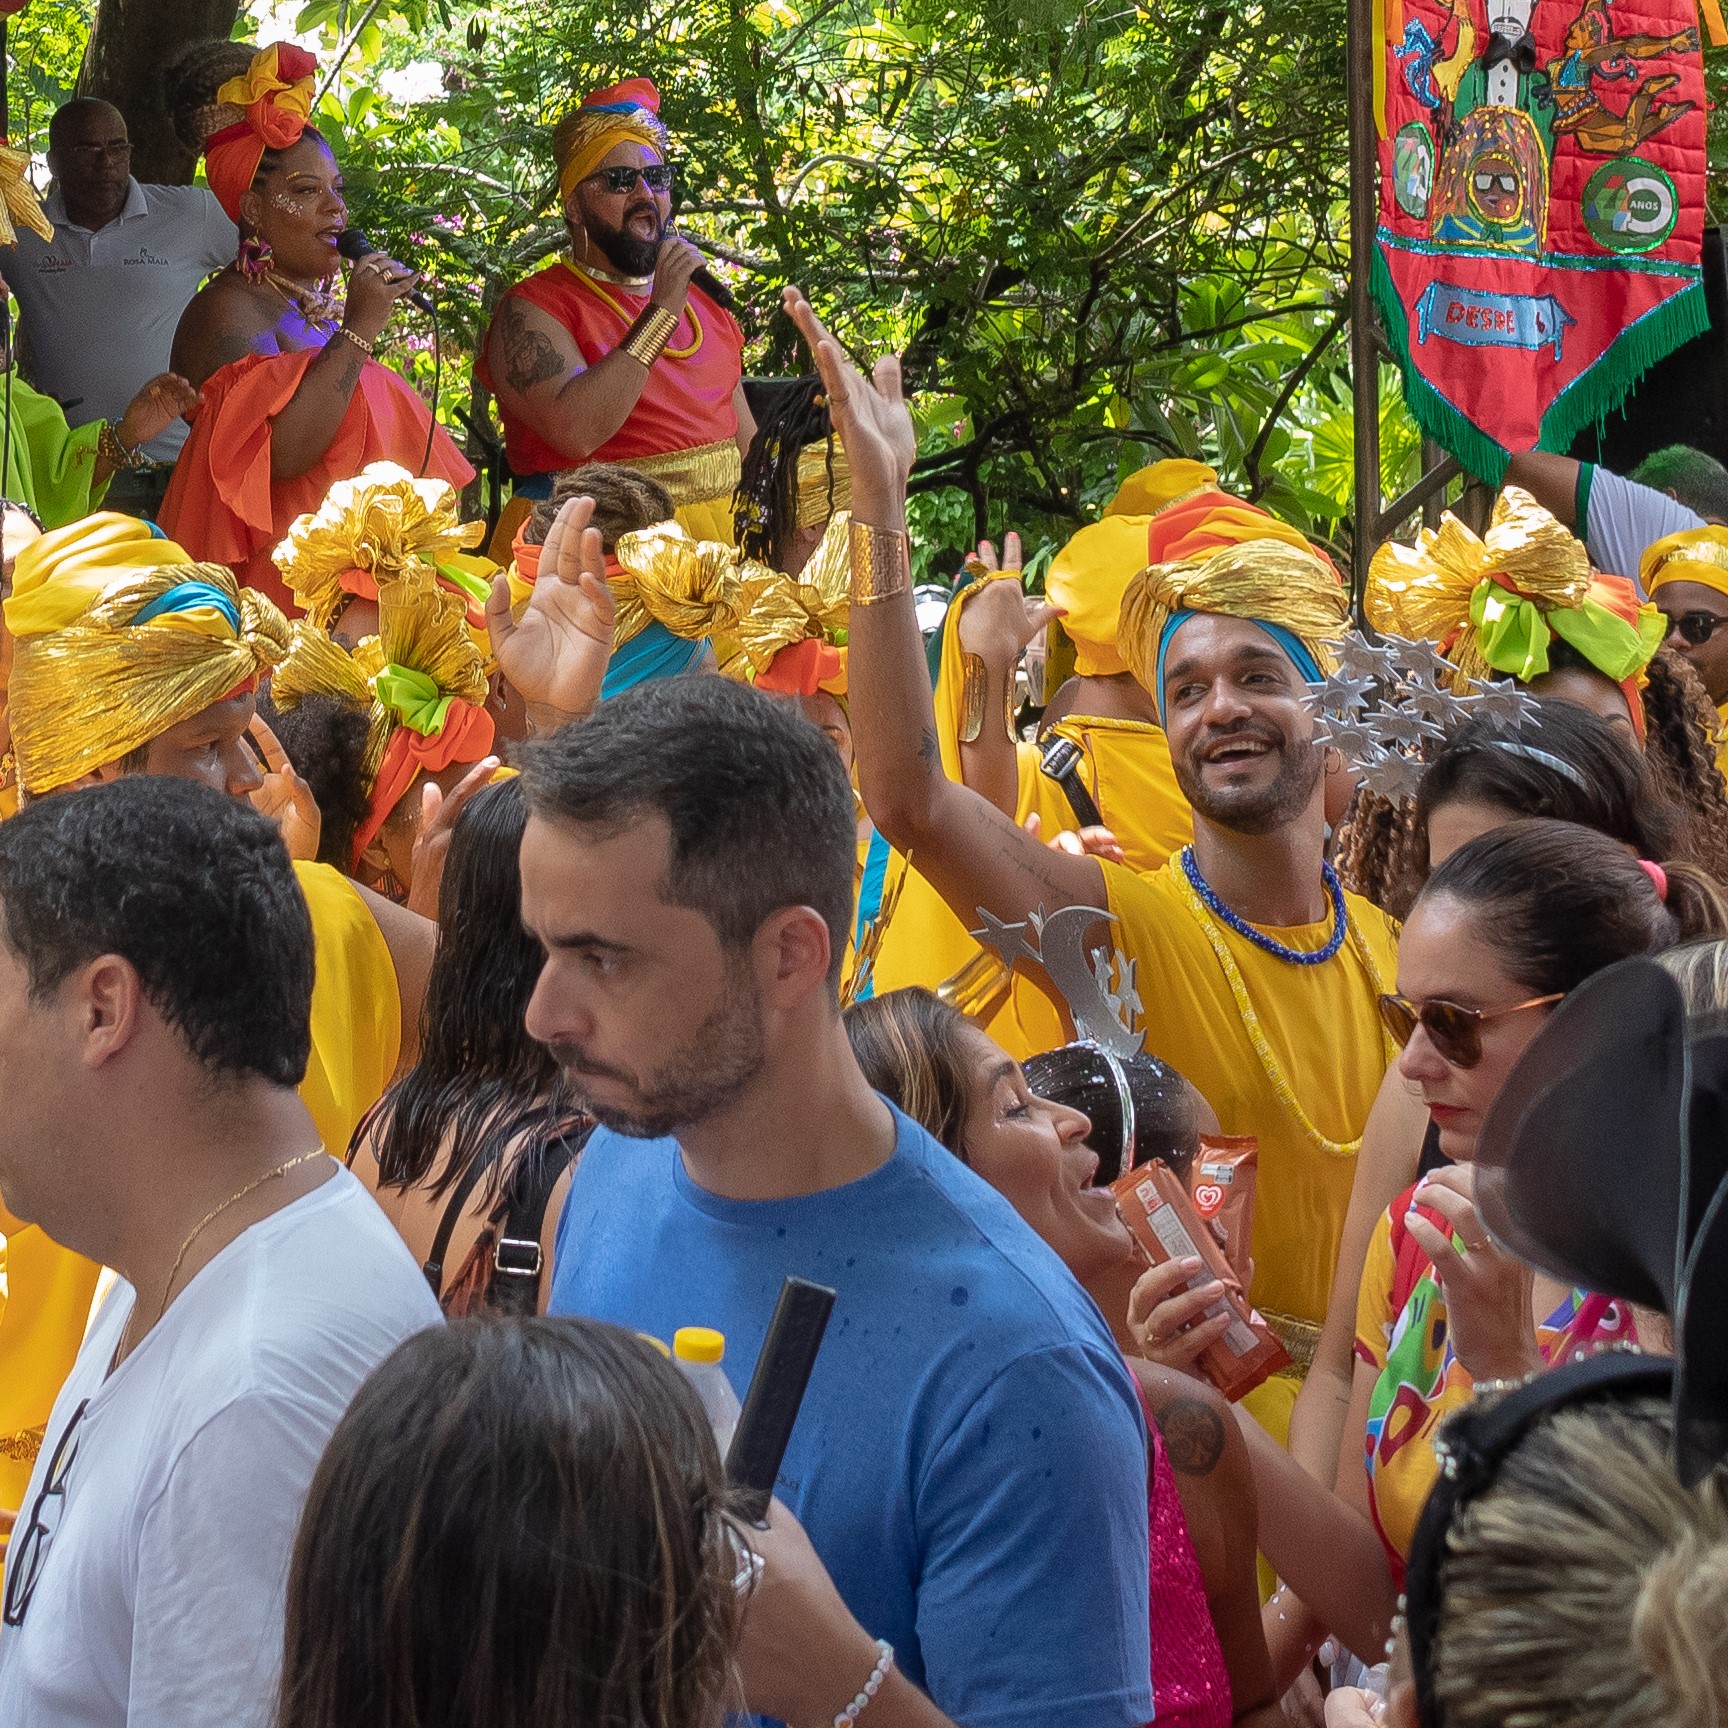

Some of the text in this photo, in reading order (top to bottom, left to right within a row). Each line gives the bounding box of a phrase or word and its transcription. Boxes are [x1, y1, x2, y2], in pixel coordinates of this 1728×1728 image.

[1630, 199, 1659, 212] ANOS
[123, 257, 170, 266] ROSA MAIA
